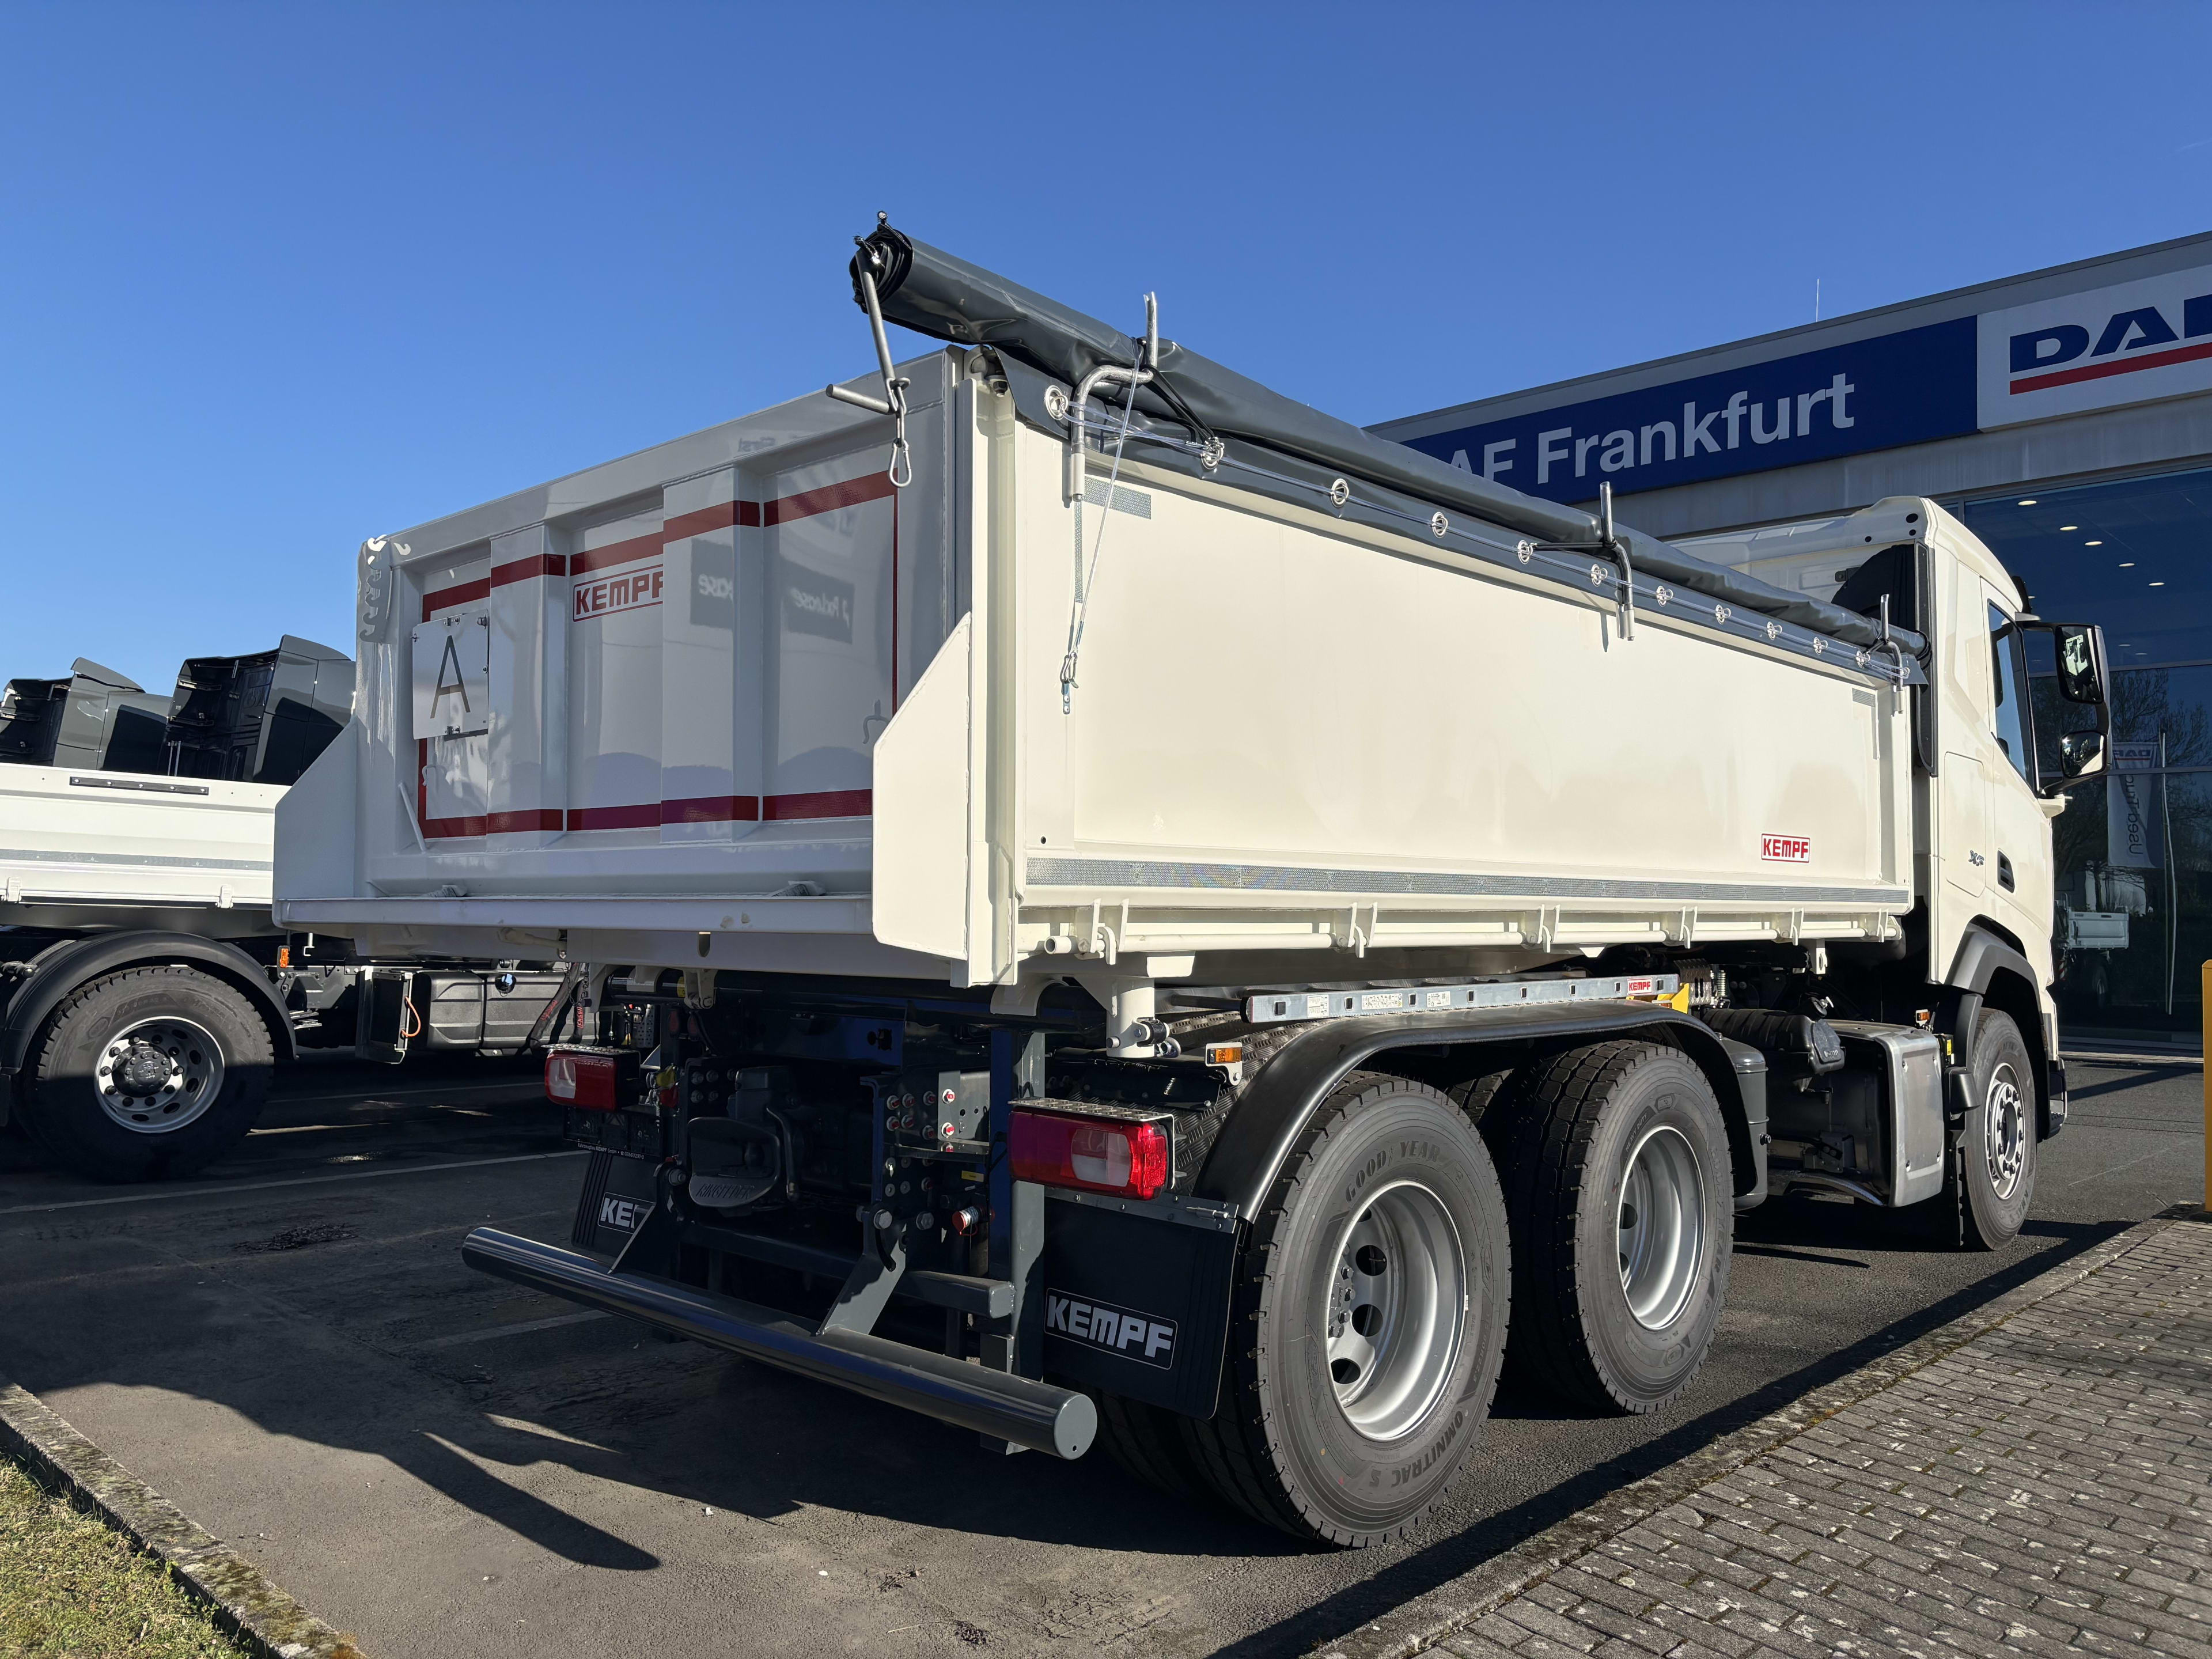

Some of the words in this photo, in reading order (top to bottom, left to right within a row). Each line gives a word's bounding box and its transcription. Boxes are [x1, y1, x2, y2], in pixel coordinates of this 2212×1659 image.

[1537, 373, 1854, 484] Frankfurt
[576, 570, 664, 615] KEMPF
[430, 635, 471, 719] A
[1763, 838, 1809, 859] KEMPF
[1628, 981, 1651, 991] KEMPF
[1346, 1150, 1387, 1202] GOOD
[1400, 1140, 1441, 1163] YEAR
[600, 1198, 639, 1229] KE
[1047, 1295, 1173, 1358] KEMPF
[1391, 1411, 1464, 1488] OMNITRAC
[1369, 1469, 1381, 1487] S
